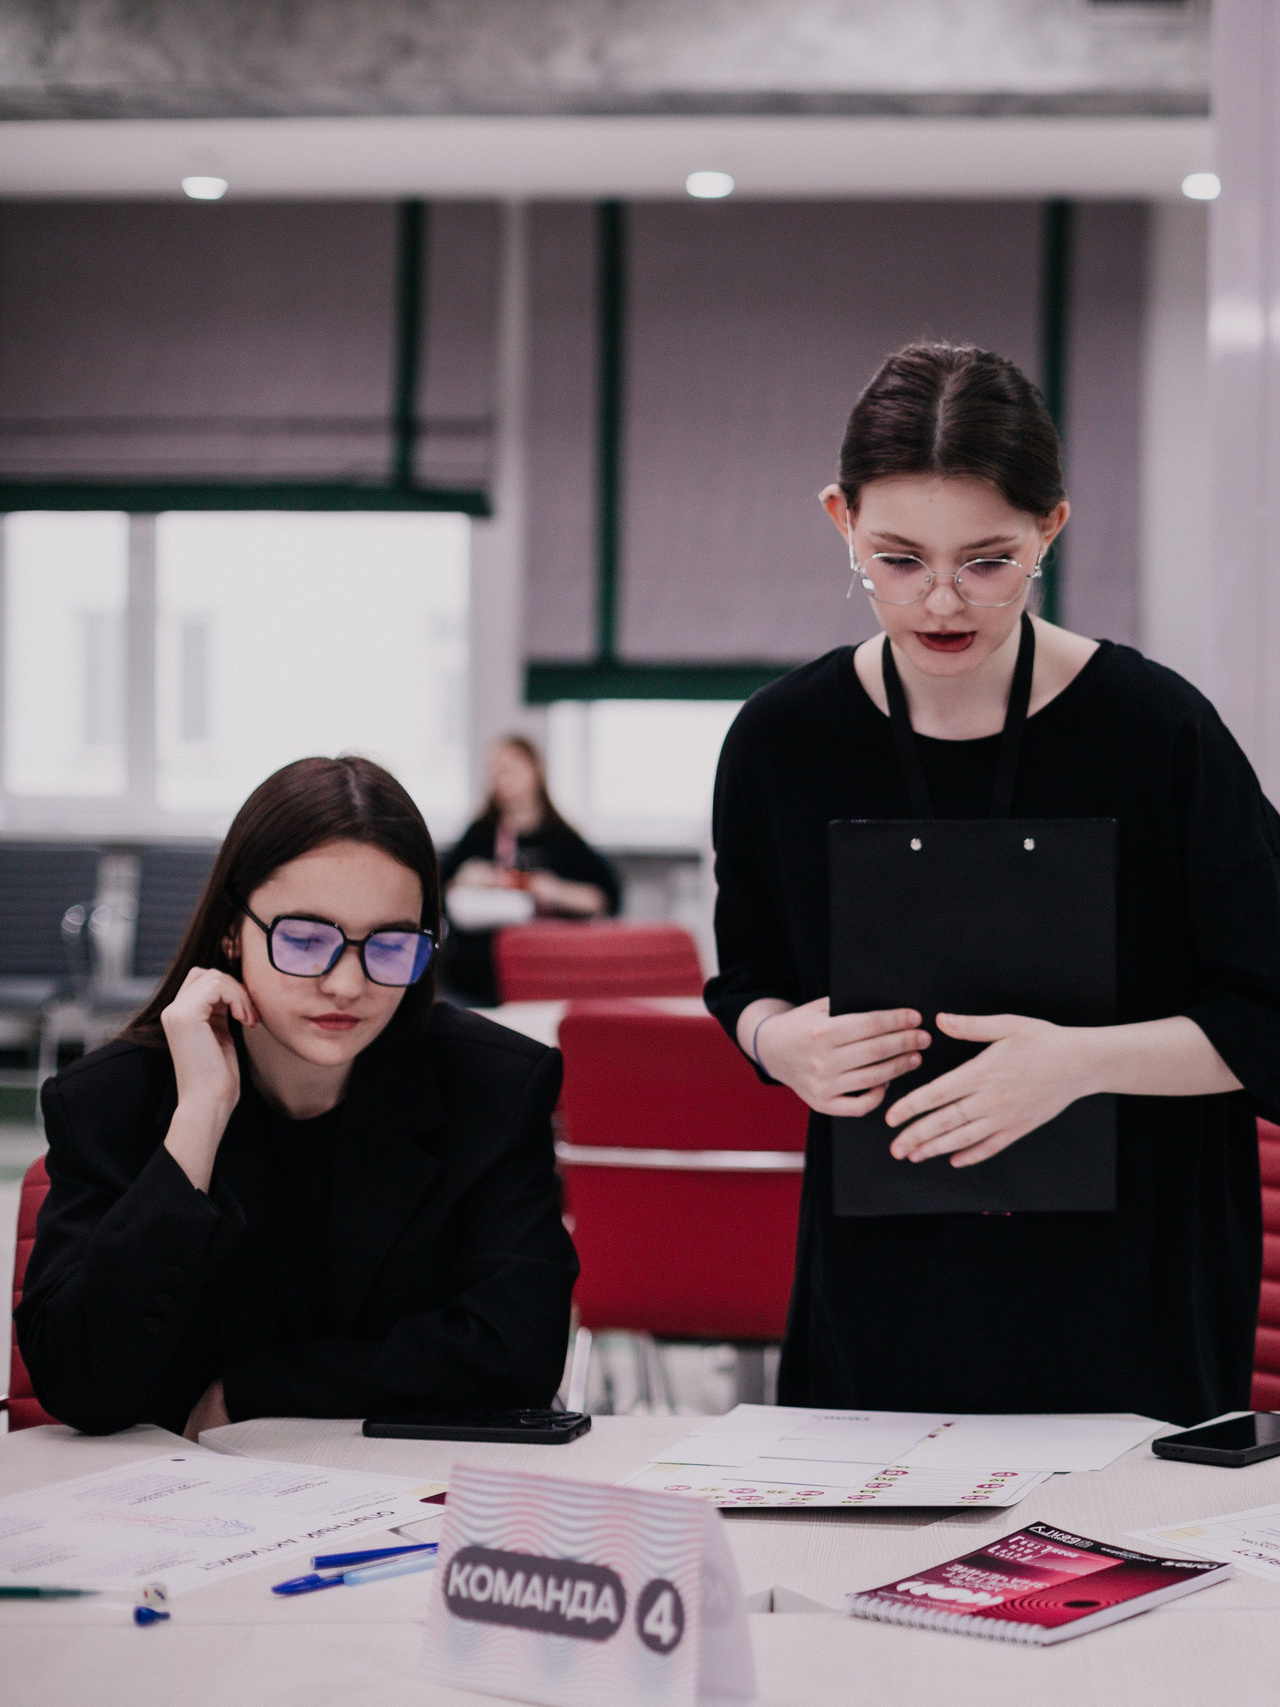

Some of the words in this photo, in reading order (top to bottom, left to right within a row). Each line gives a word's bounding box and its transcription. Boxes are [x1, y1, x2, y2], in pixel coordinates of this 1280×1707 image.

[300, 1510, 396, 1539] ОПЫТНЫЙ
[197, 1538, 298, 1570] АКТИВИСТ
[448, 1561, 621, 1625] КОМАНДА
[643, 1589, 679, 1646] 4
